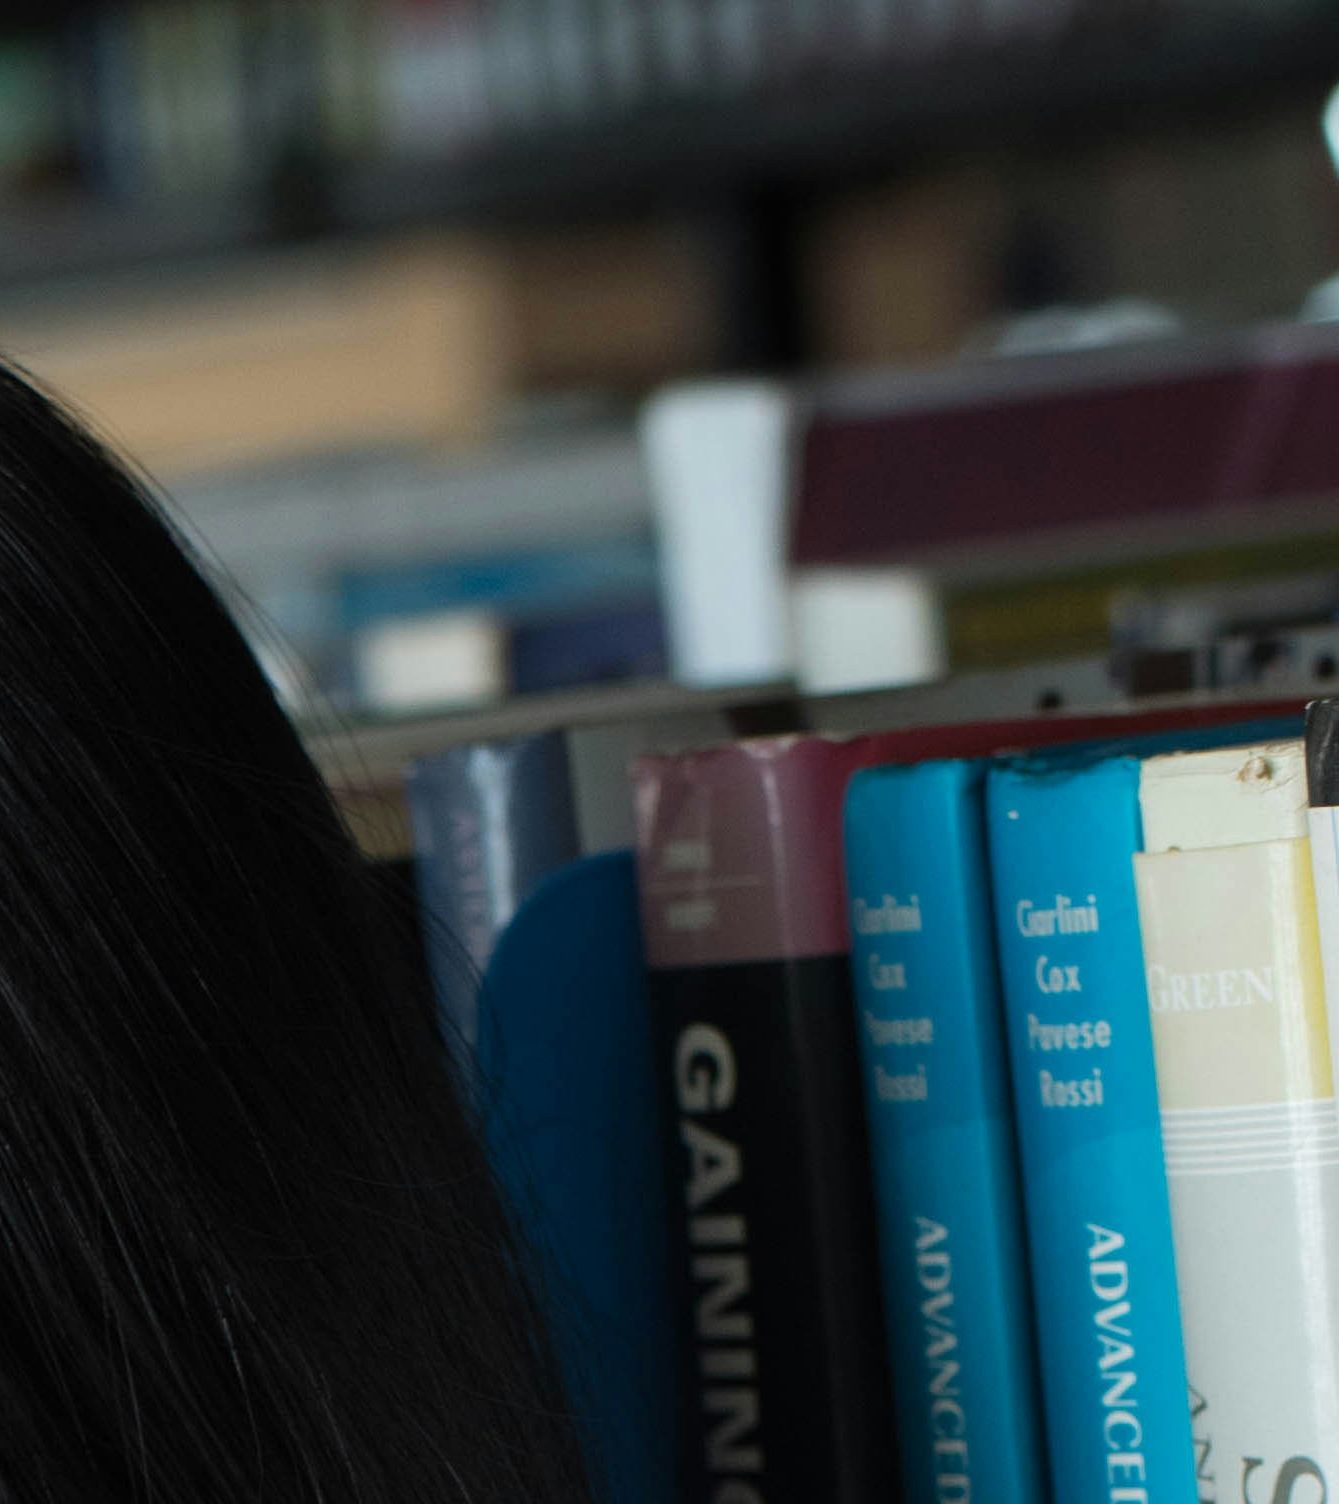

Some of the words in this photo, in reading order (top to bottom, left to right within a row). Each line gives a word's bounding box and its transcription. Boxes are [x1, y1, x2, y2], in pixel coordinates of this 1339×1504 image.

[1035, 953, 1081, 994] Cox
[1148, 964, 1276, 1013] GREEN
[1027, 1012, 1112, 1052] Pavese
[1039, 1067, 1104, 1107] Rossi
